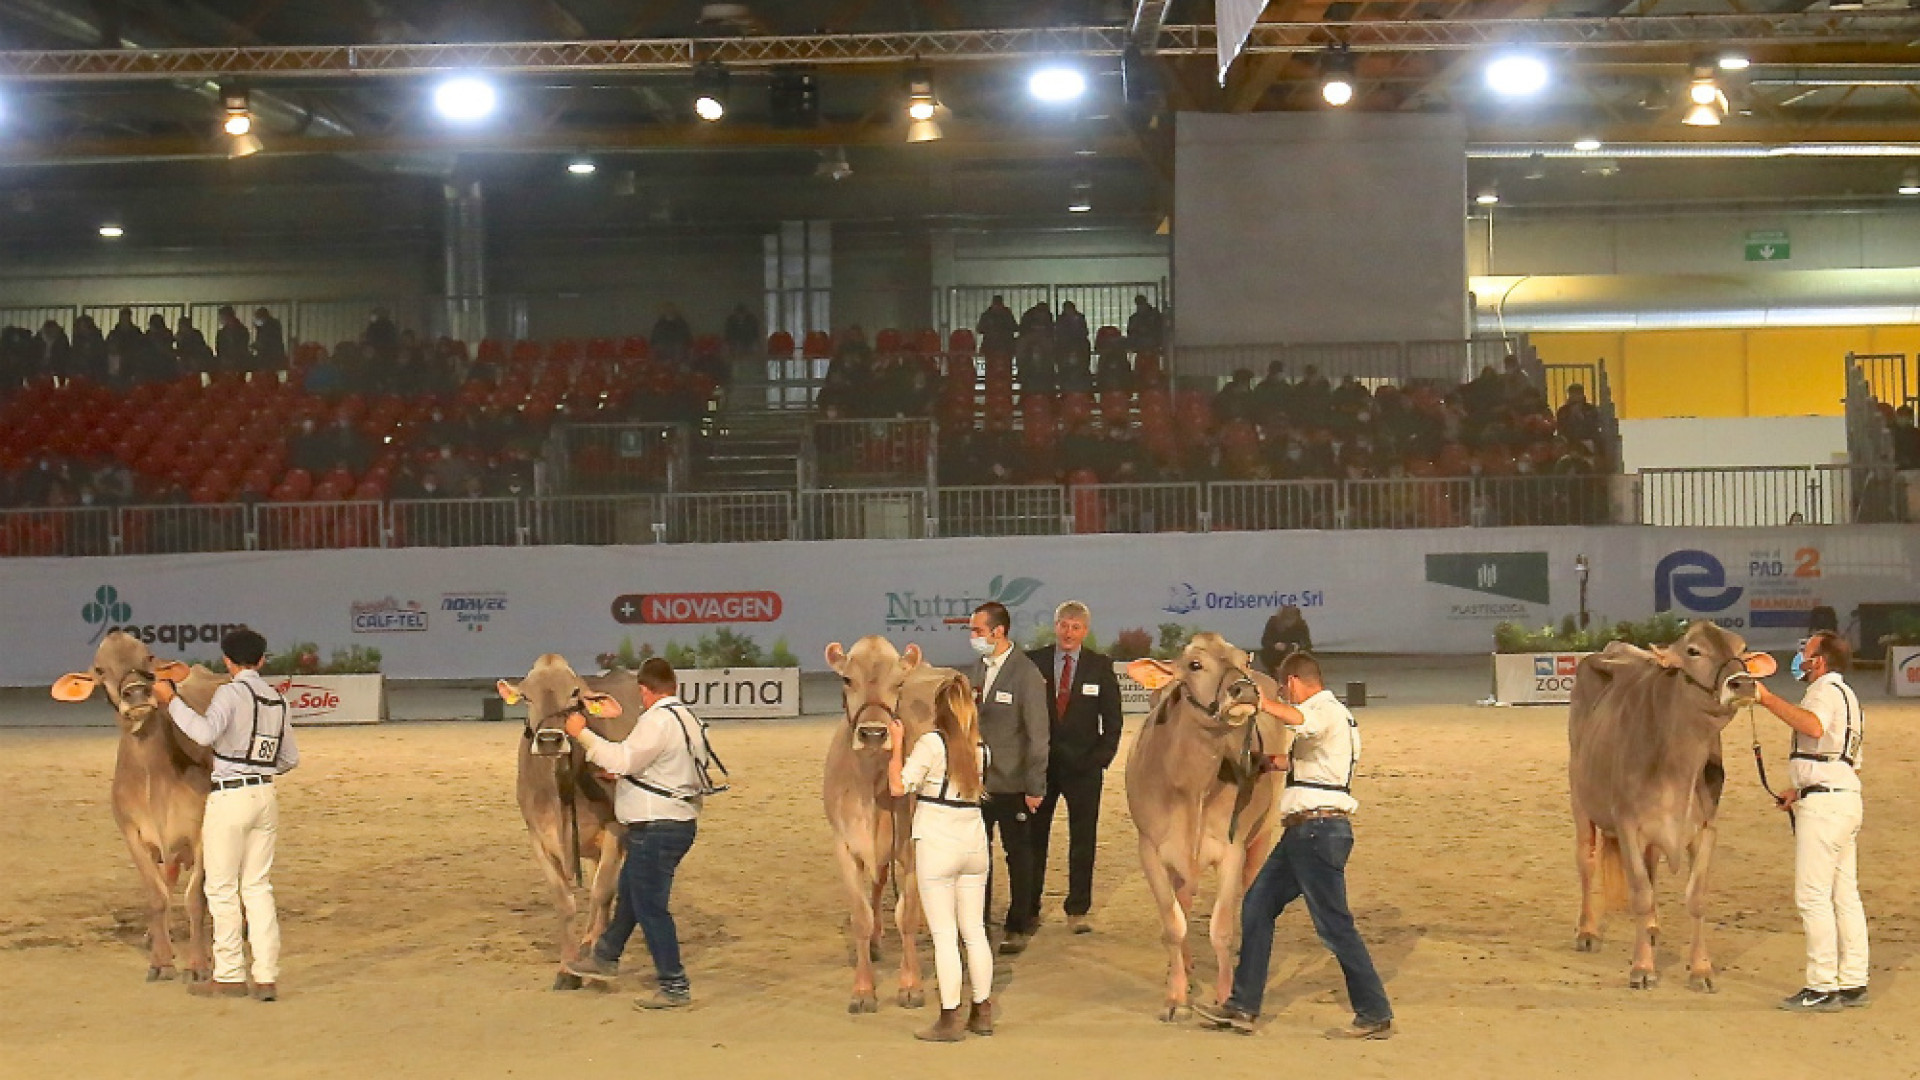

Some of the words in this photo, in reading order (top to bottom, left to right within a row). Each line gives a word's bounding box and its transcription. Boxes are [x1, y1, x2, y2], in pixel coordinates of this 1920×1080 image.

[1794, 546, 1822, 578] 2
[652, 596, 774, 620] NOVAGEN
[1206, 591, 1297, 609] Orziservice
[1302, 590, 1324, 607] Srl
[356, 615, 424, 628] CALF-TEL
[680, 669, 783, 705] urina
[299, 691, 340, 709] Sole
[258, 740, 276, 760] 89
